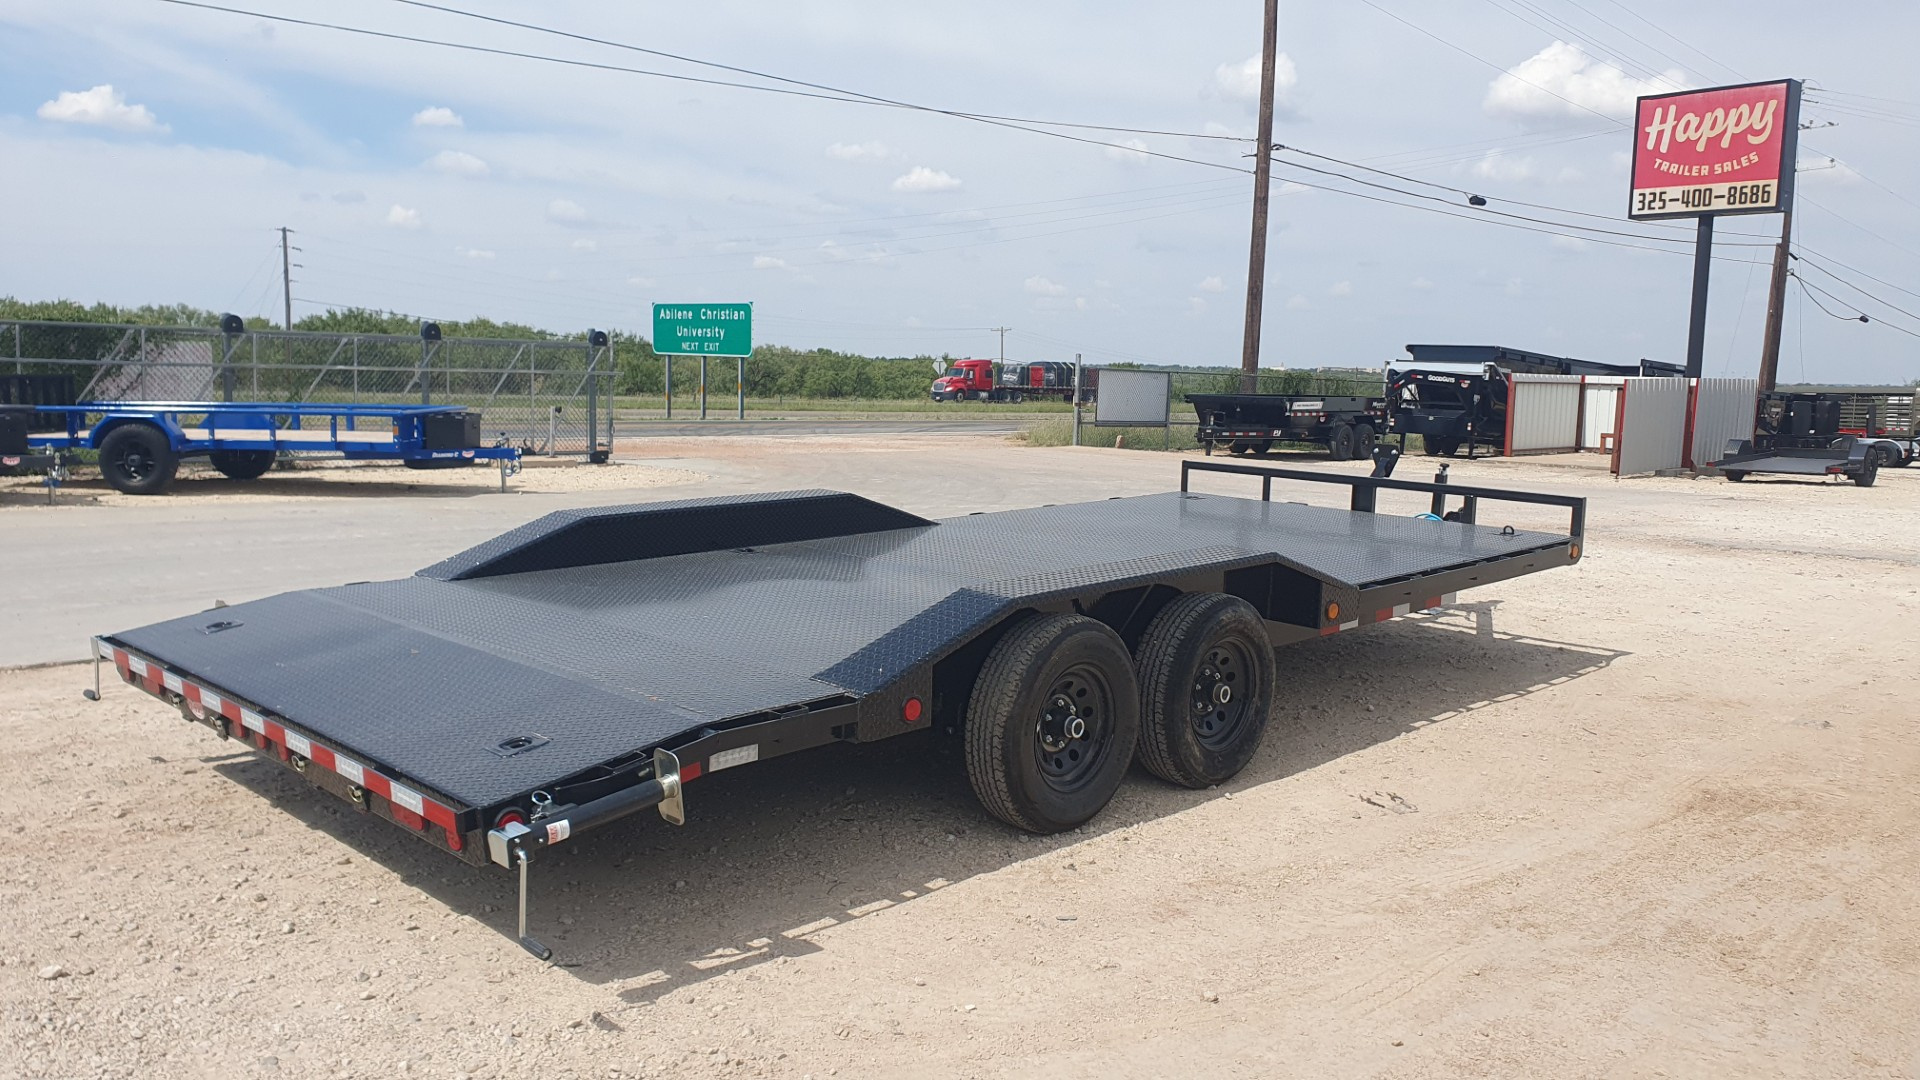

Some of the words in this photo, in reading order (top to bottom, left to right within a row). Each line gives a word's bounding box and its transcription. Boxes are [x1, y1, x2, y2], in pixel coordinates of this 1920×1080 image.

[1645, 99, 1778, 153] Happy
[1653, 158, 1709, 176] TRAILER
[1714, 151, 1759, 175] SALES
[1637, 184, 1771, 211] 325-400-8686
[659, 308, 693, 320] Abilene
[700, 308, 745, 320] Christian
[676, 325, 725, 340] University
[681, 342, 699, 350] NEXT
[704, 342, 720, 351] EXIT
